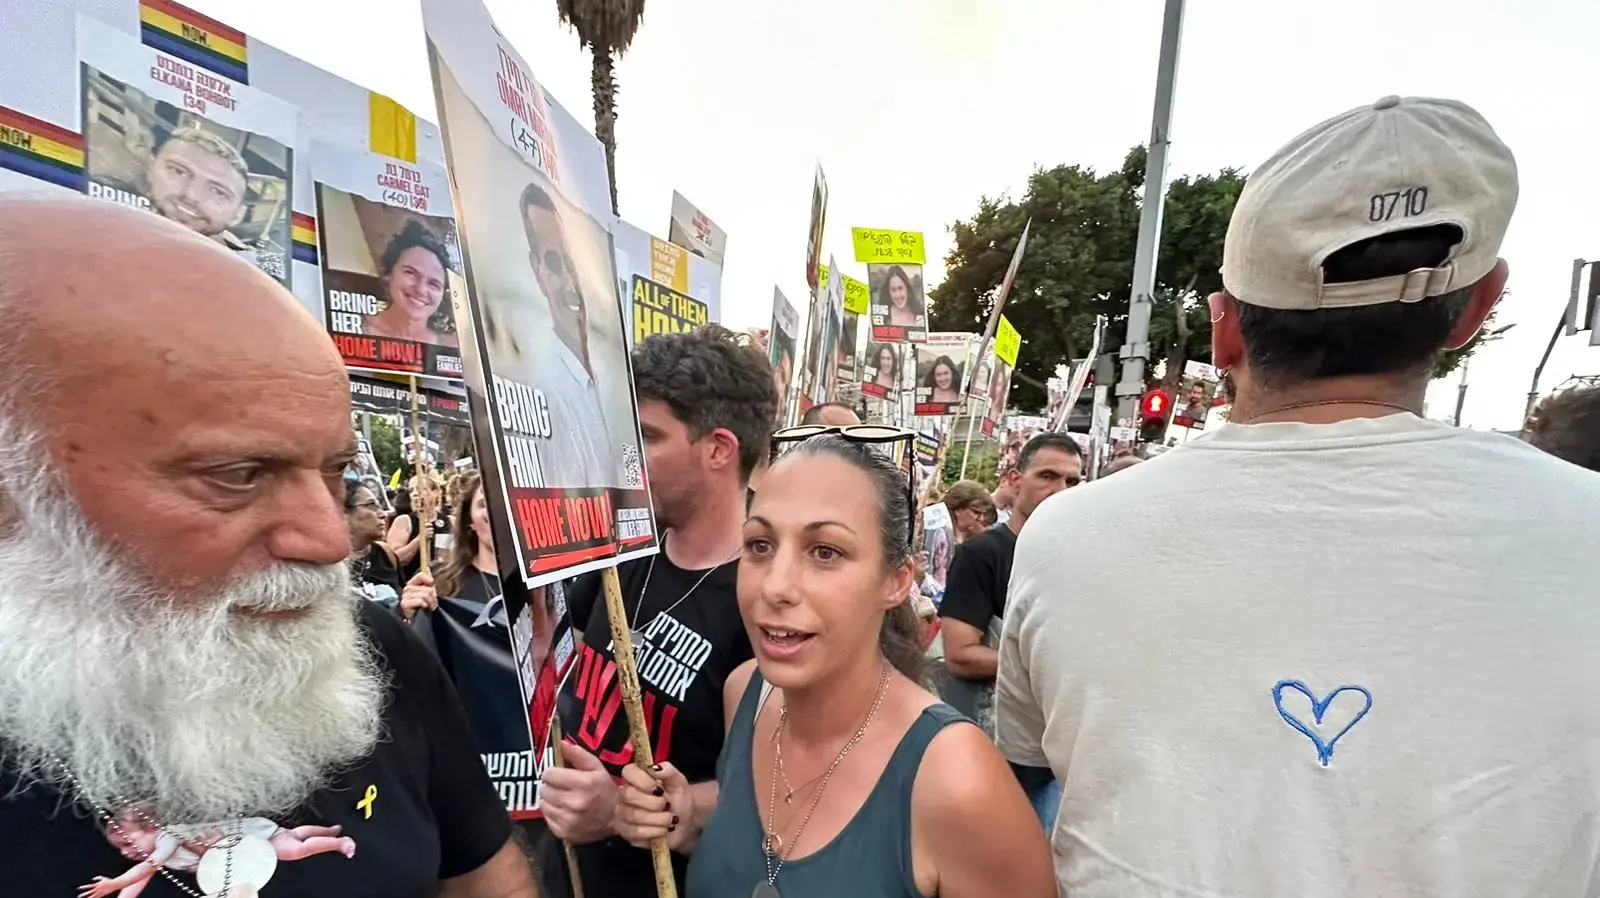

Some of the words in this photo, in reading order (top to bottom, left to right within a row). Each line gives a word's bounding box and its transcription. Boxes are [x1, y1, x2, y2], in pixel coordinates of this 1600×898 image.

[150, 65, 194, 94] ELKANA
[510, 117, 542, 167] (47)
[376, 174, 413, 194] CARMEL
[414, 184, 431, 199] GAT
[1369, 186, 1428, 222] 0710
[329, 289, 378, 316] BRING
[633, 278, 663, 311] ALL
[669, 292, 707, 325] THEM
[331, 311, 364, 334] HER
[333, 334, 377, 358] HOME
[380, 340, 423, 364] NOW!
[492, 373, 552, 438] BRING
[503, 435, 545, 488] HIM
[516, 497, 568, 550] HOME
[564, 490, 617, 542] NOW!
[643, 610, 713, 671] מחזירים
